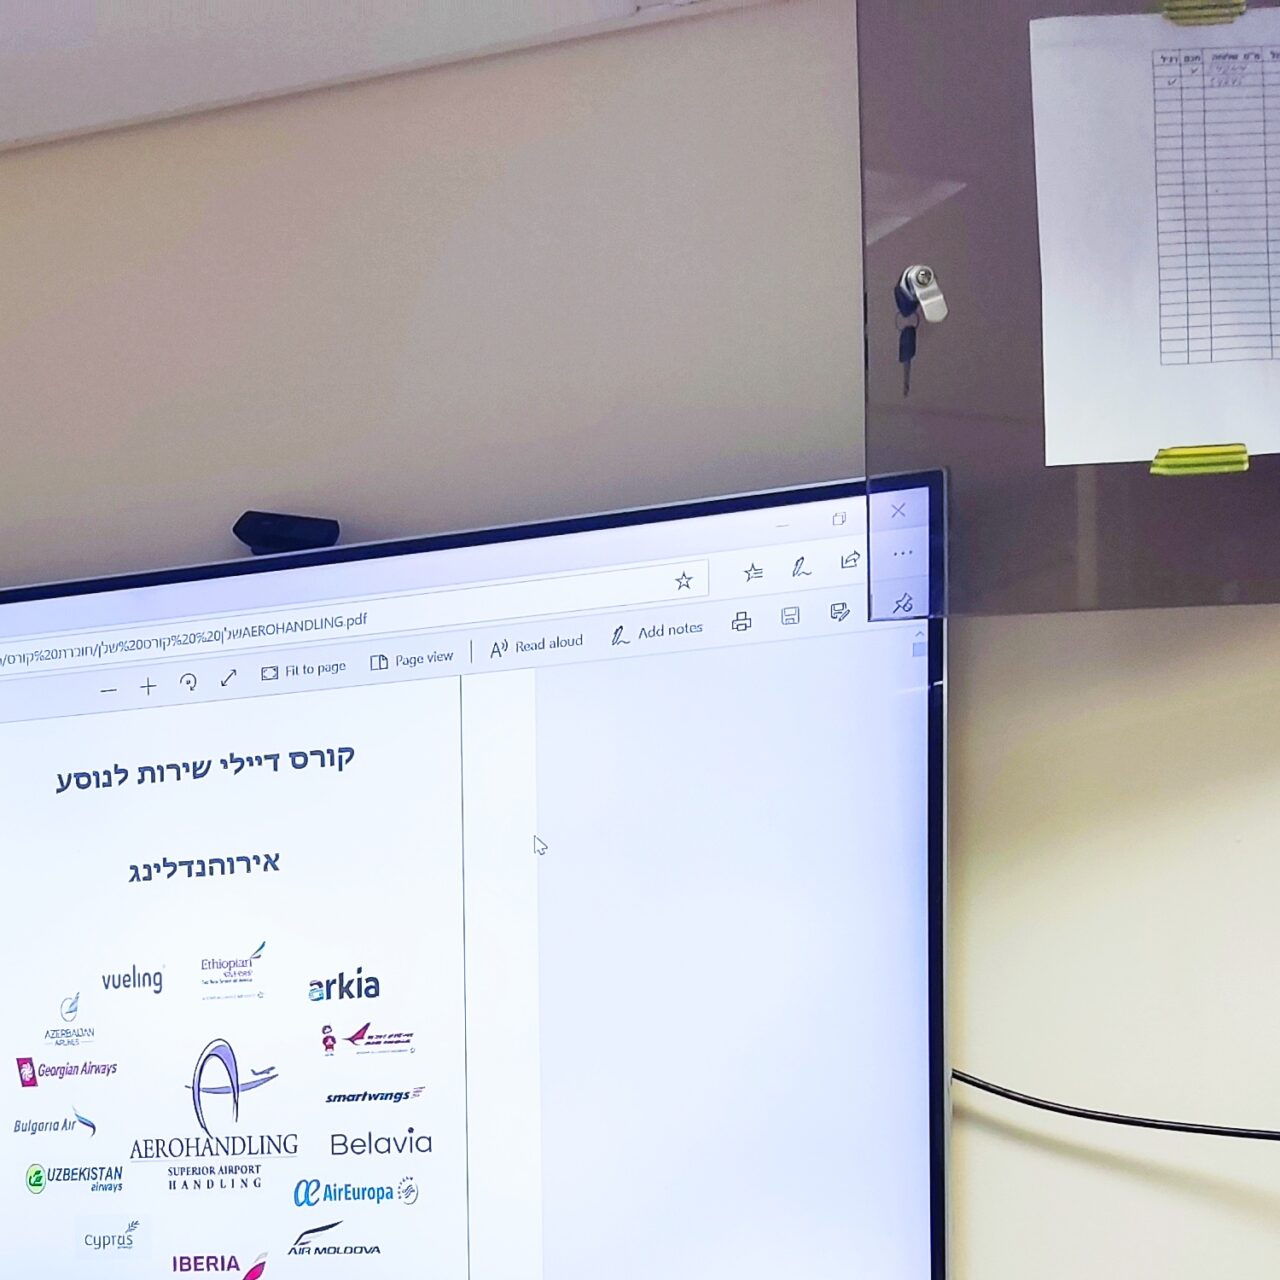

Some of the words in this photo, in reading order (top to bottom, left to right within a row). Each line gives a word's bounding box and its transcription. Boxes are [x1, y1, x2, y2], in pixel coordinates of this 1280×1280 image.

[638, 624, 664, 639] Add
[668, 622, 703, 636] notes
[515, 637, 545, 653] Read
[549, 634, 583, 649] aloud
[395, 654, 424, 668] Page
[427, 651, 454, 663] view
[285, 665, 299, 677] Fit
[303, 663, 315, 675] to
[318, 661, 346, 676] page
[220, 752, 280, 775] דיילי
[289, 746, 355, 772] קורס
[55, 763, 128, 794] לנוסע
[137, 758, 212, 785] שירות
[128, 851, 280, 883] אירוהנדלינג
[201, 958, 252, 971] Ethiopian
[102, 964, 163, 994] vueling
[308, 966, 380, 1002] arkia
[37, 1062, 79, 1079] Georgian
[80, 1061, 118, 1077] Airways
[325, 1090, 410, 1103] smartwings
[13, 1119, 59, 1135] Bulgaria
[61, 1118, 77, 1131] Air
[129, 1133, 298, 1159] AEROHANDLING
[330, 1127, 432, 1155] Belavia
[47, 1166, 123, 1182] UZBEKISTAN
[168, 1165, 215, 1176] SUPERIOR
[218, 1164, 261, 1175] AIRPORT
[91, 1182, 123, 1193] airways
[168, 1177, 262, 1190] HANDLING
[323, 1183, 394, 1204] AirEuropa
[288, 1246, 311, 1255] AIR
[314, 1246, 381, 1255] MOLDOVA
[172, 1255, 241, 1272] IBERIA
